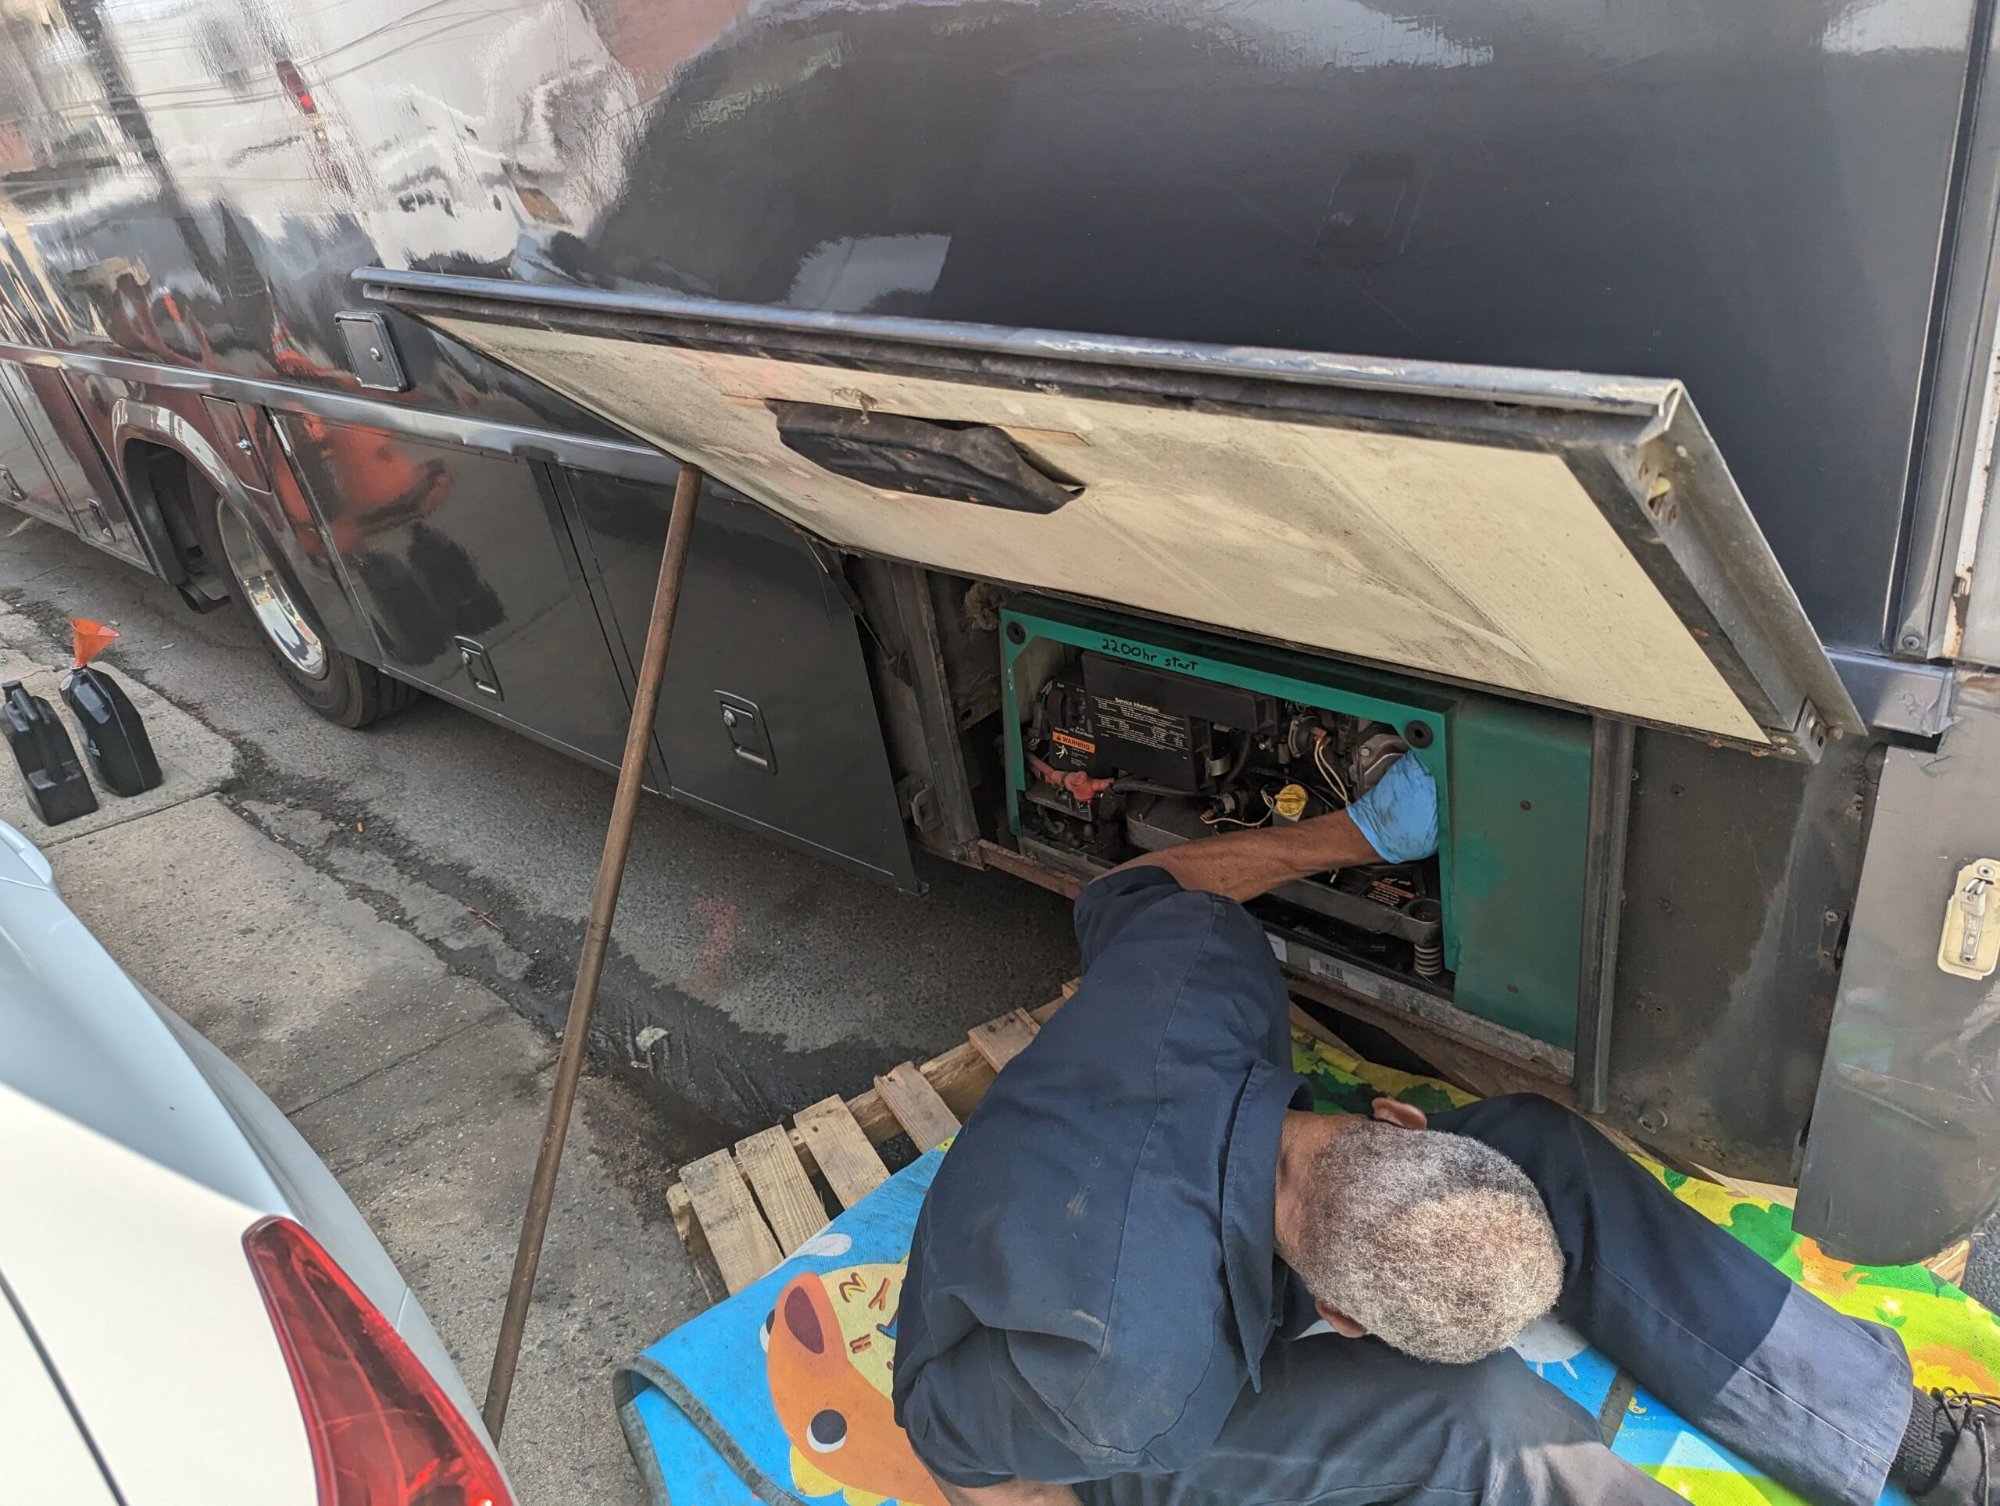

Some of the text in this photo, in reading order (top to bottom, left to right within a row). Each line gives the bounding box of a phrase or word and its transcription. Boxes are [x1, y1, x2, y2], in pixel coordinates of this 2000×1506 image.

[1102, 638, 1157, 662] 2200hr
[1115, 697, 1132, 706] Service
[1133, 701, 1160, 714] Information
[1062, 736, 1090, 750] WARNING
